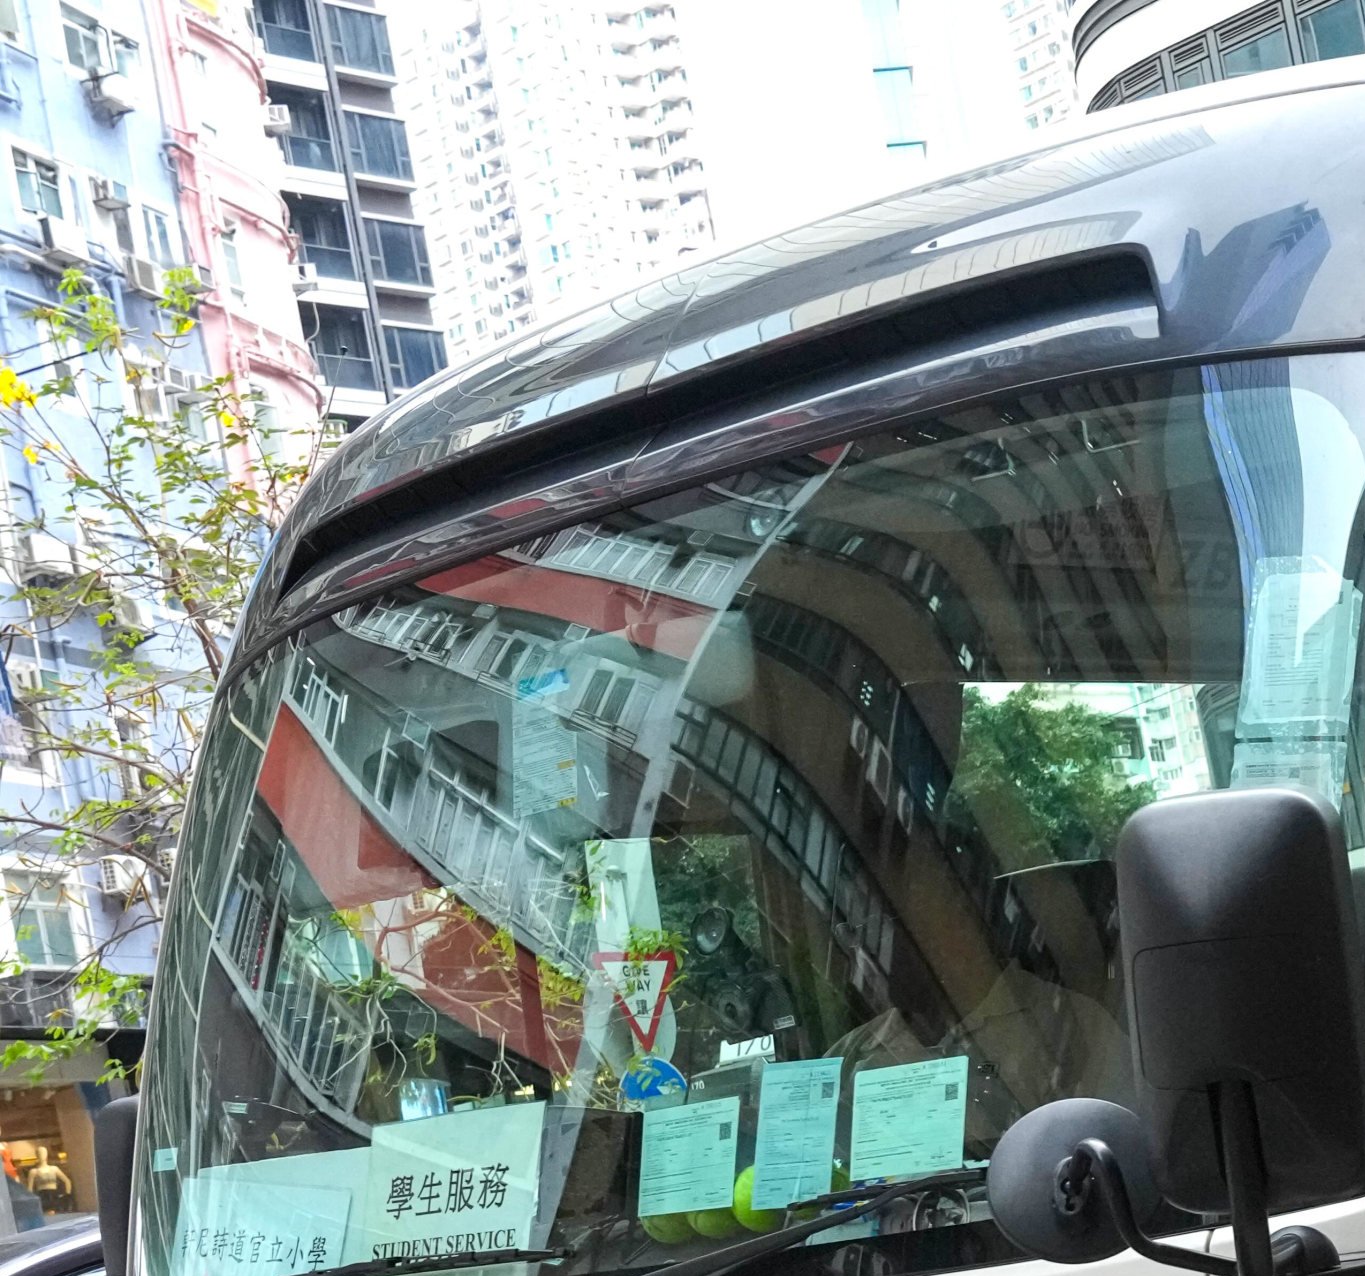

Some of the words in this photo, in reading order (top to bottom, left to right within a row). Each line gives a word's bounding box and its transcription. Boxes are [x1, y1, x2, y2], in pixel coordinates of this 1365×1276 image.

[385, 1162, 509, 1221] 學生服務
[371, 1235, 443, 1261] STUDENT
[445, 1227, 516, 1254] SERVICE
